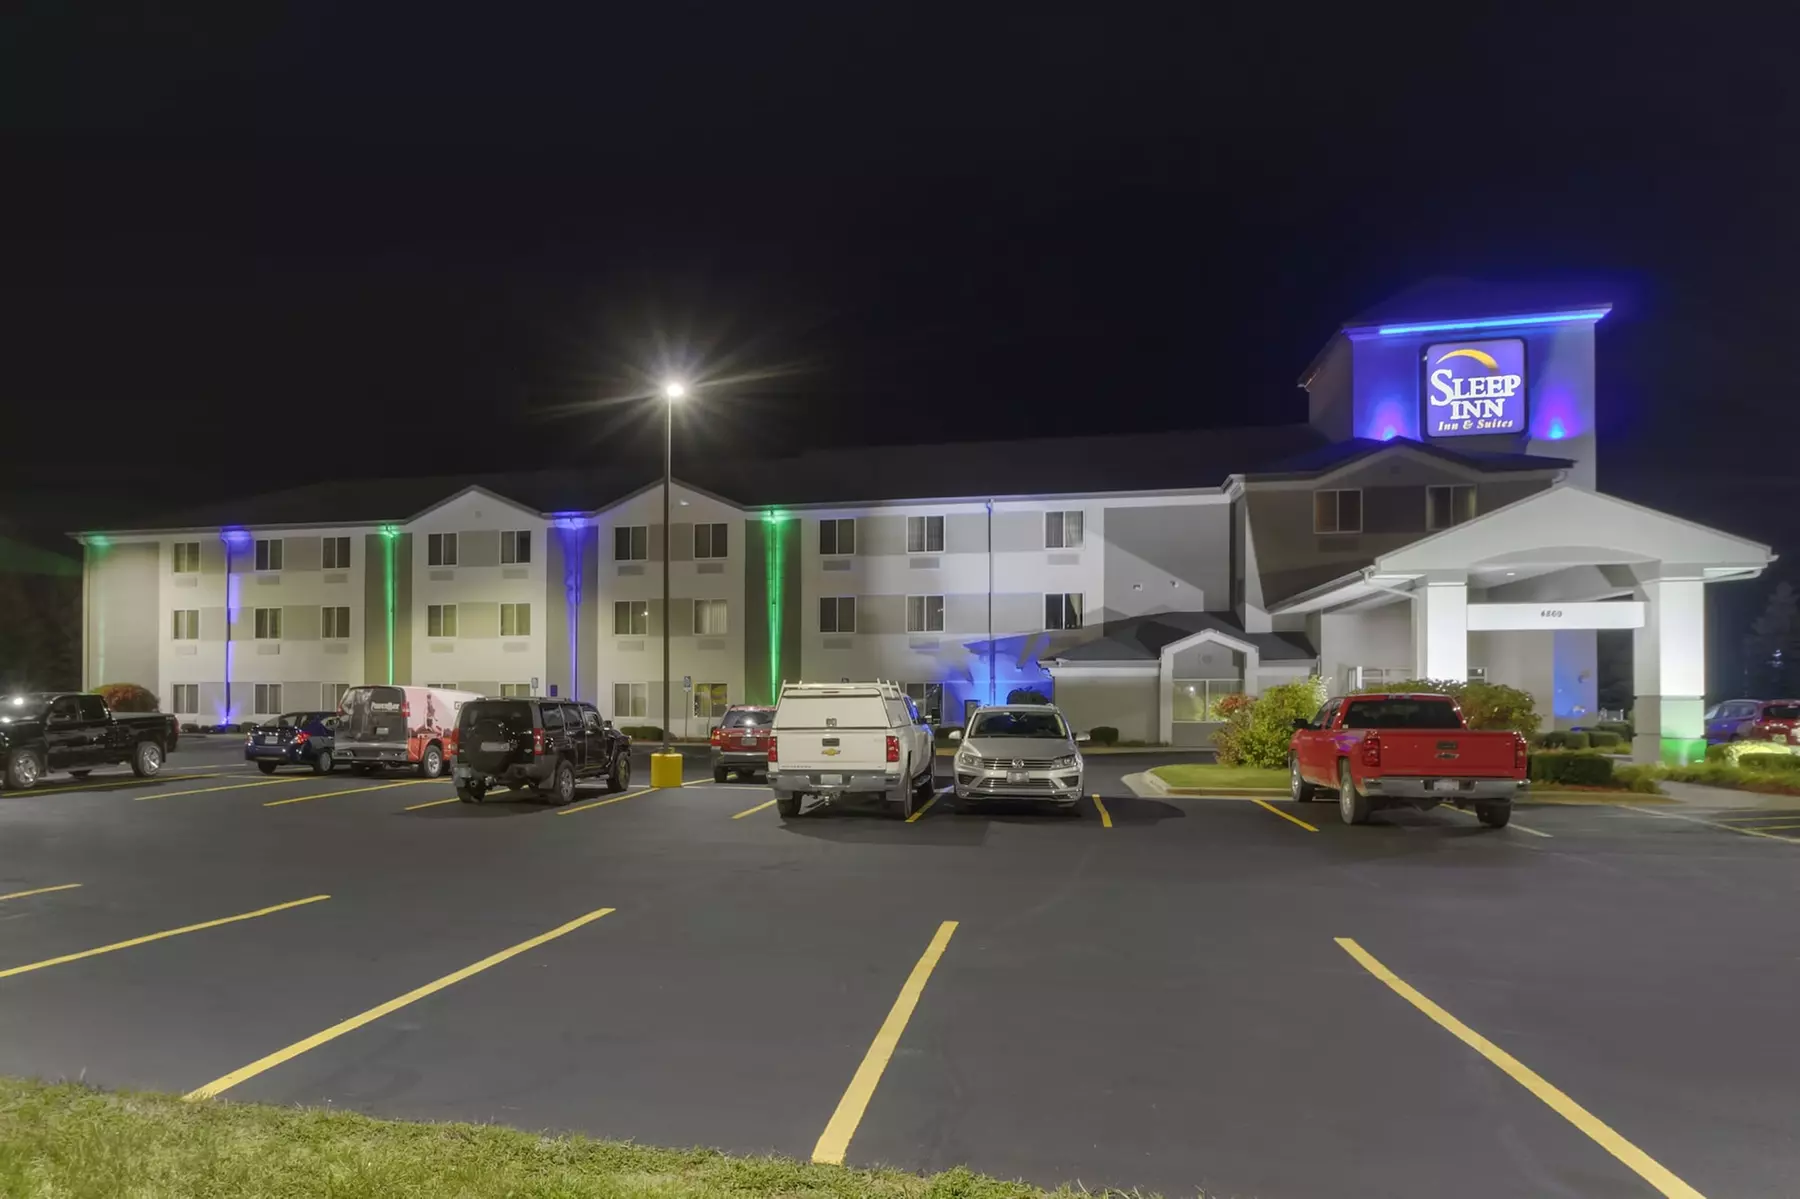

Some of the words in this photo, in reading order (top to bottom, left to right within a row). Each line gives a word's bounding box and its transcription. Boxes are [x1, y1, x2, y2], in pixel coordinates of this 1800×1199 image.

[1430, 369, 1521, 406] SLEEP
[1450, 398, 1505, 419] INN
[1438, 421, 1459, 431] Inn
[1462, 420, 1473, 430] &
[1476, 418, 1513, 430] Suites
